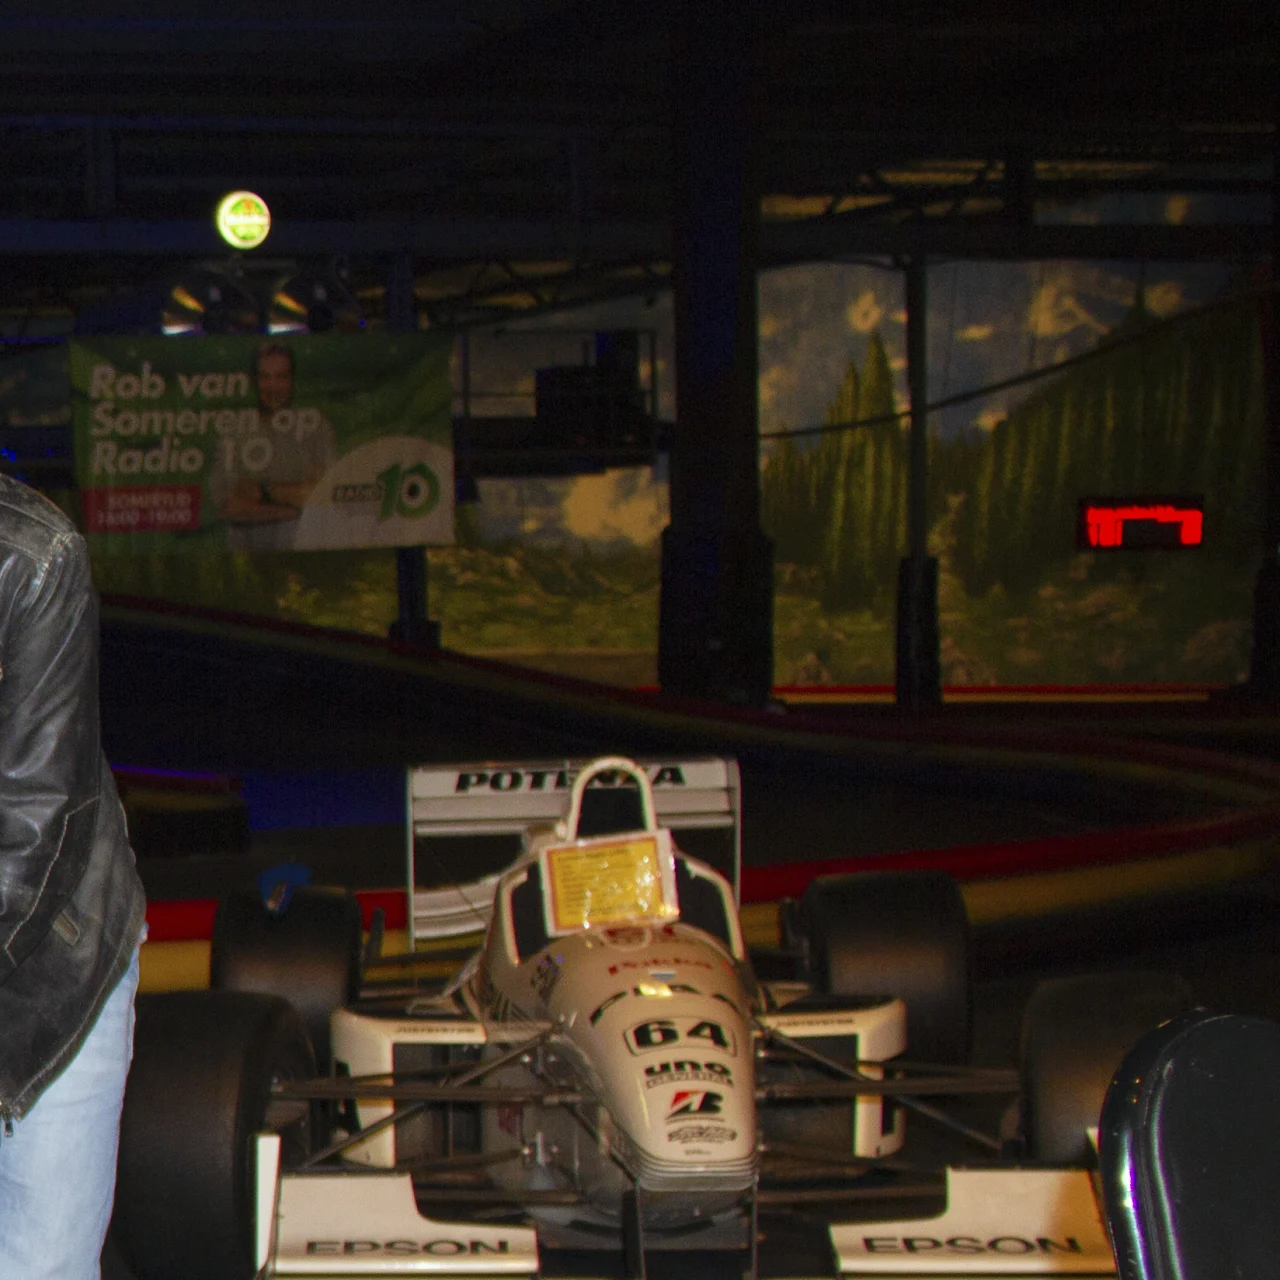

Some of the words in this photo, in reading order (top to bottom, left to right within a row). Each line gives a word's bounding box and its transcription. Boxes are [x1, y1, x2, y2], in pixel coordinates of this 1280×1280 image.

[90, 361, 165, 399] Rob
[179, 372, 249, 397] van
[92, 402, 260, 435] Someren
[271, 408, 322, 442] op
[93, 436, 205, 474] Radio
[223, 438, 274, 473] 10
[377, 462, 440, 522] 10
[634, 1020, 729, 1049] 64
[306, 1239, 509, 1255] EPSON
[862, 1236, 1083, 1254] EPSON
